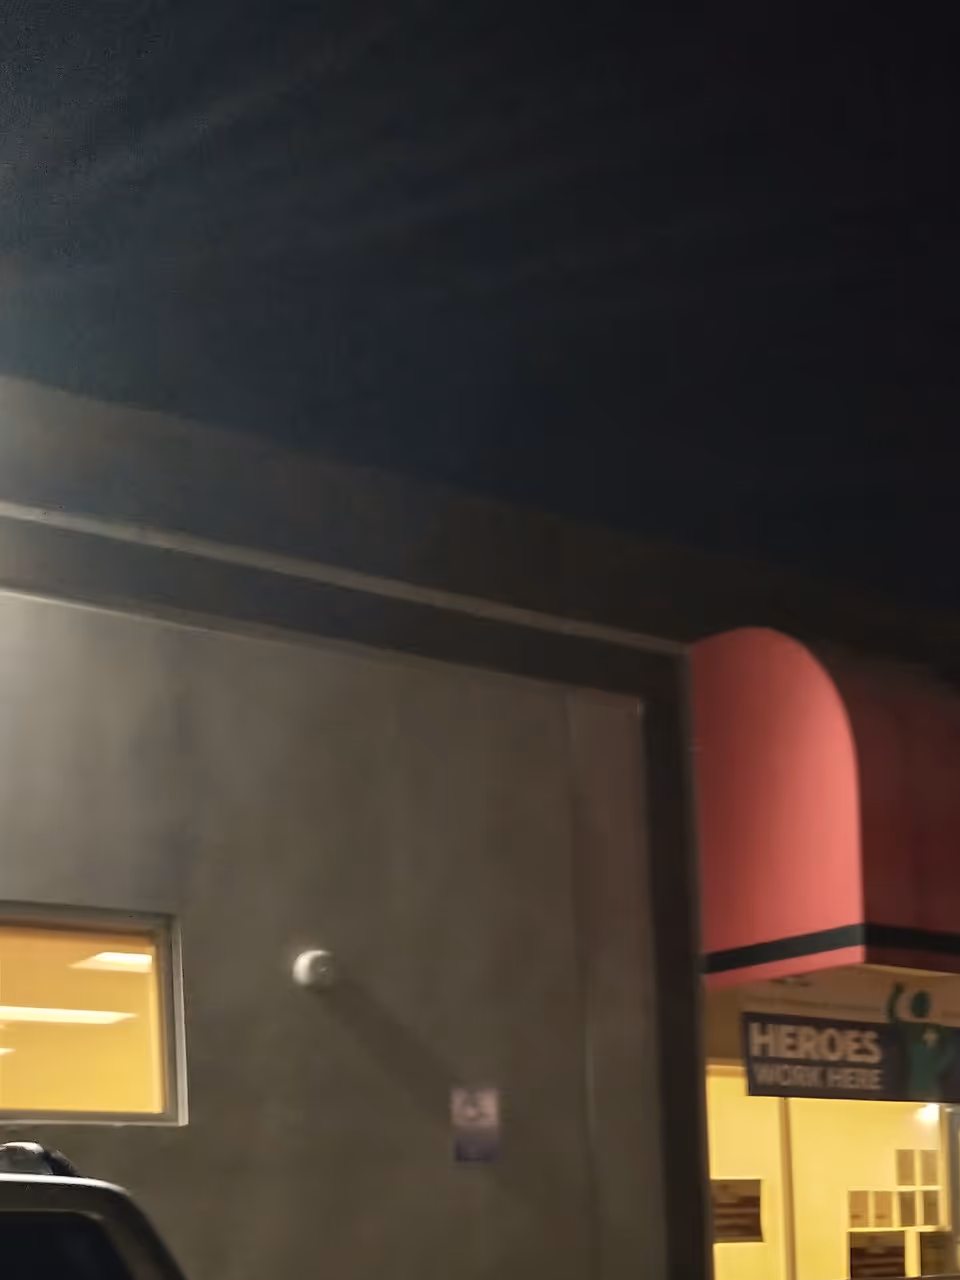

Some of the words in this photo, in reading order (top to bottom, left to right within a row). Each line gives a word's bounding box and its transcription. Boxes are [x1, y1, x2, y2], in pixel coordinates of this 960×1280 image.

[751, 1023, 882, 1063] HEROES
[753, 1064, 820, 1087] WORK
[829, 1068, 882, 1090] HERE
